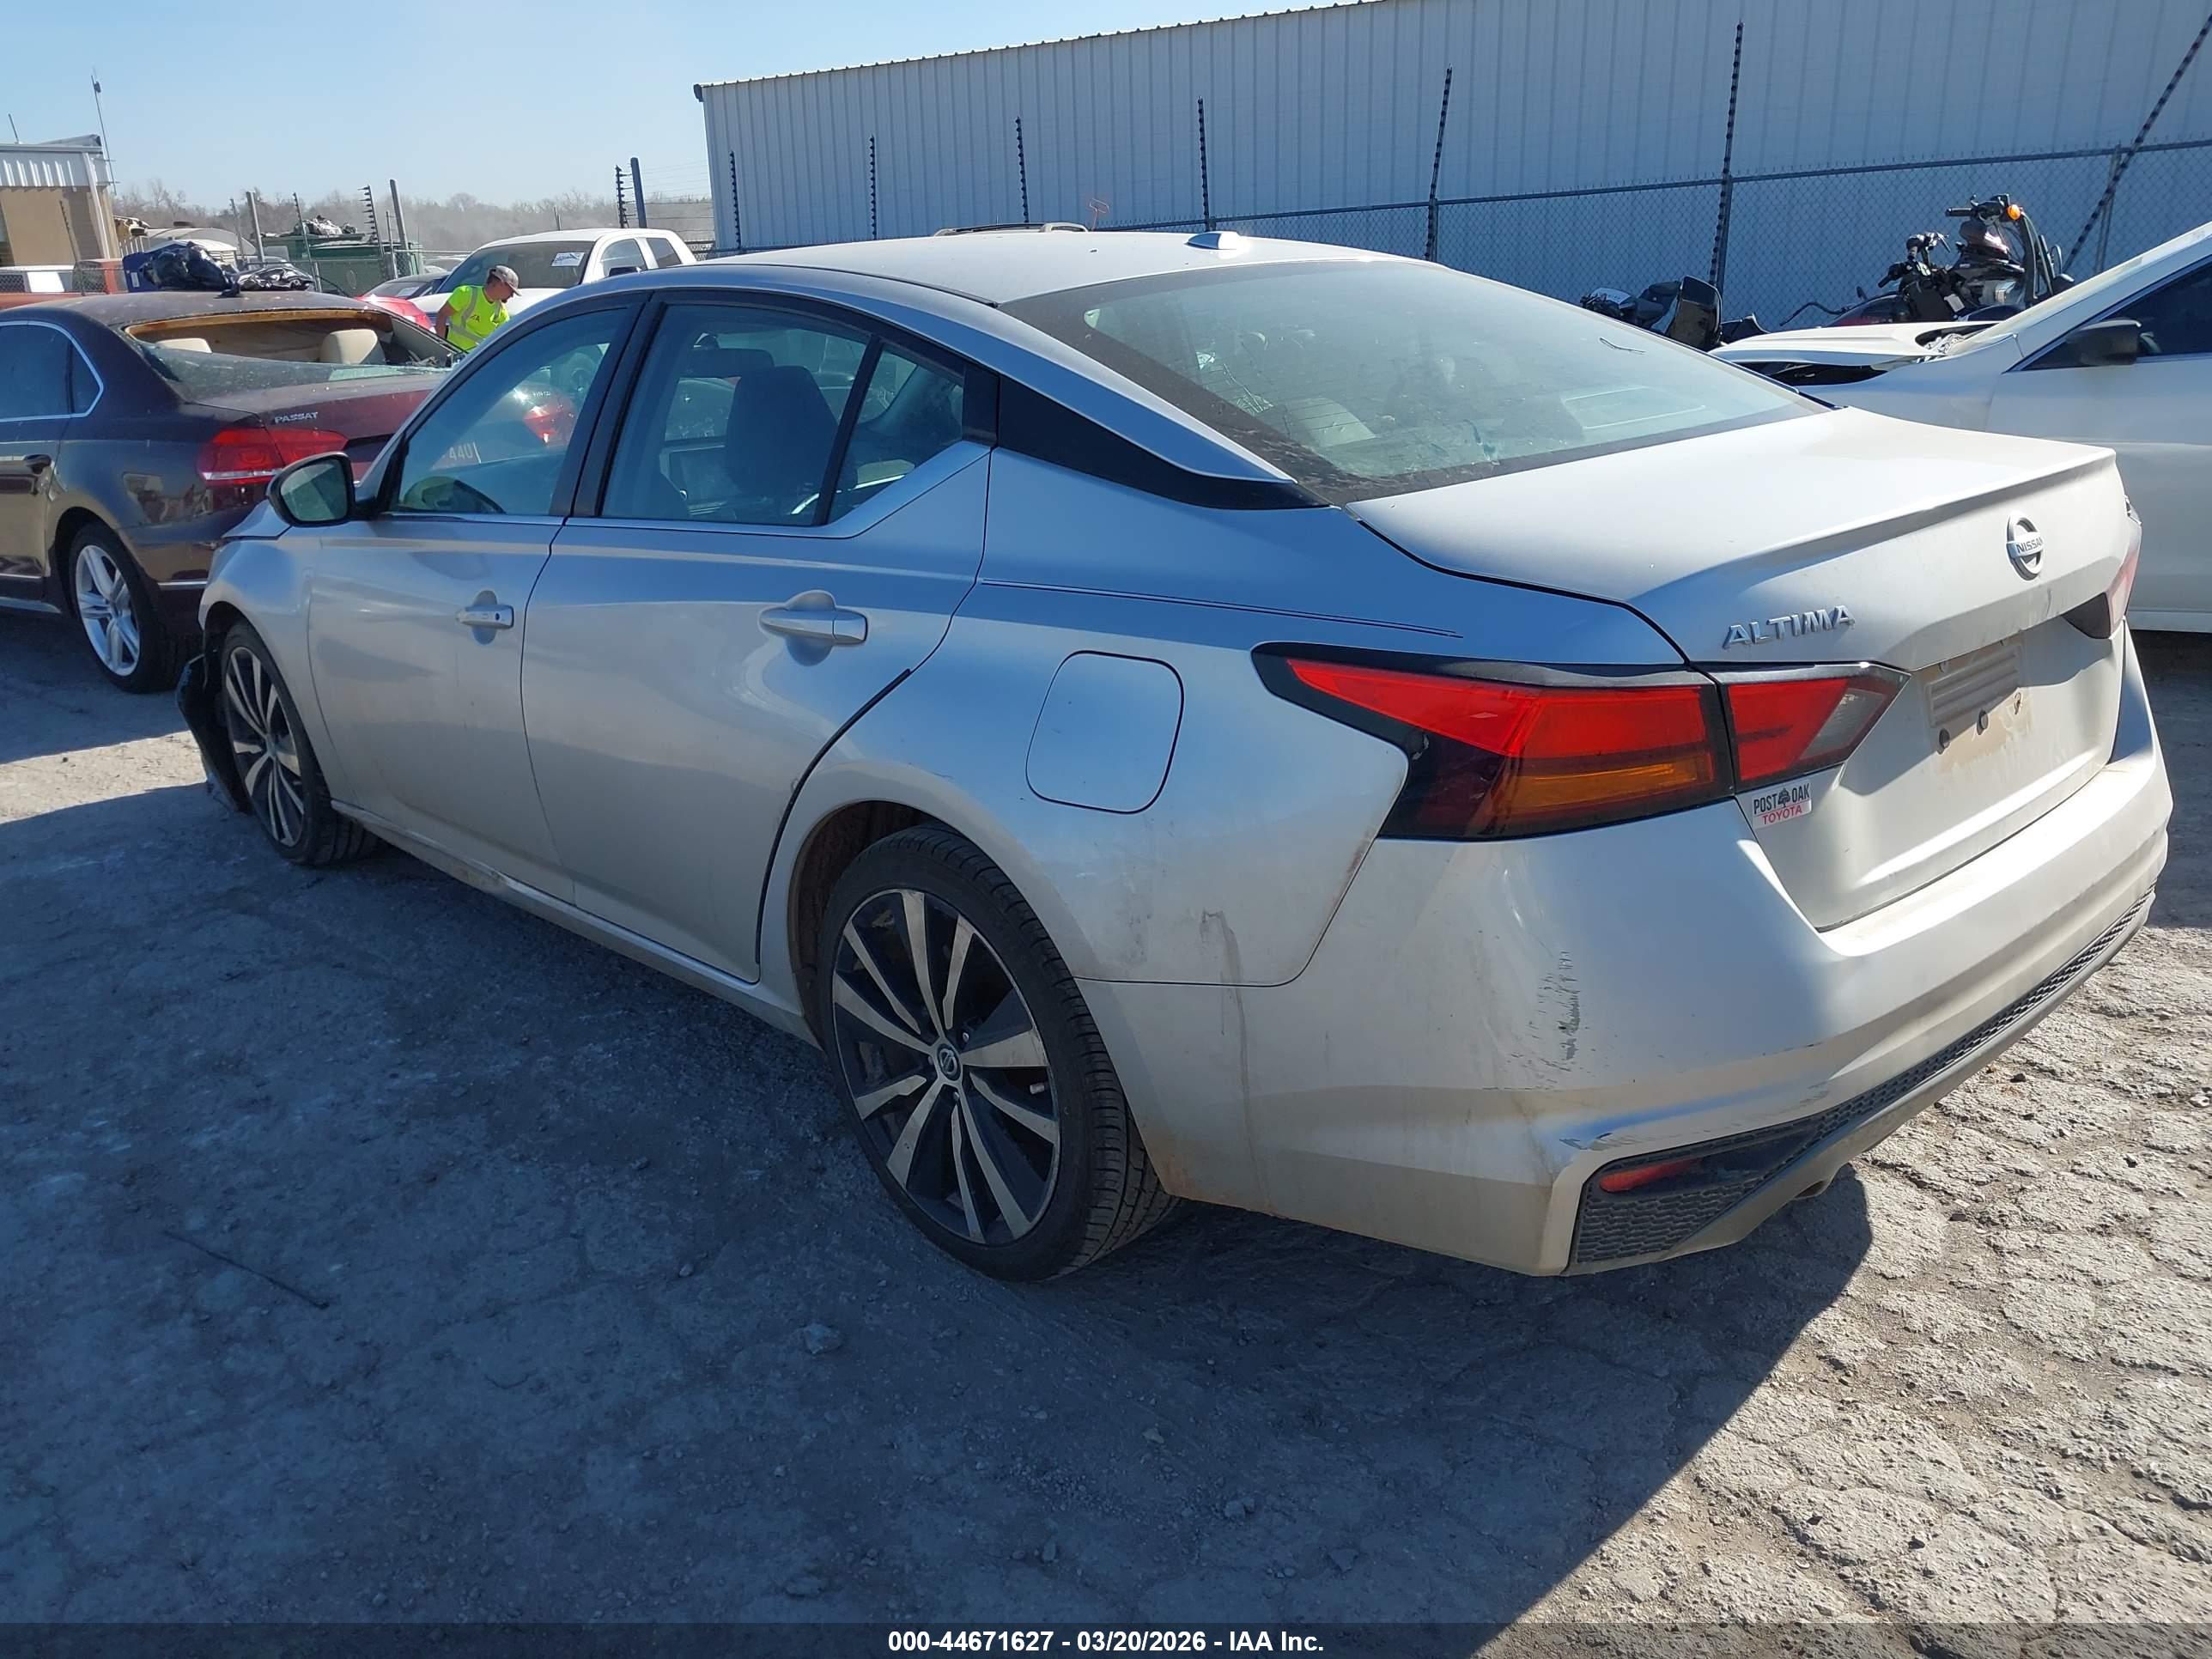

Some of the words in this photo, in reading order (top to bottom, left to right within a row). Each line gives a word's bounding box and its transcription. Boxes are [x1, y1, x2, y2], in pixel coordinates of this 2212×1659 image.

[275, 412, 318, 423] PASSAT
[1722, 605, 1856, 650] ALTIMA
[1753, 793, 1778, 815] POST
[1791, 782, 1810, 803] OAK
[1762, 805, 1802, 824] TOYOTA
